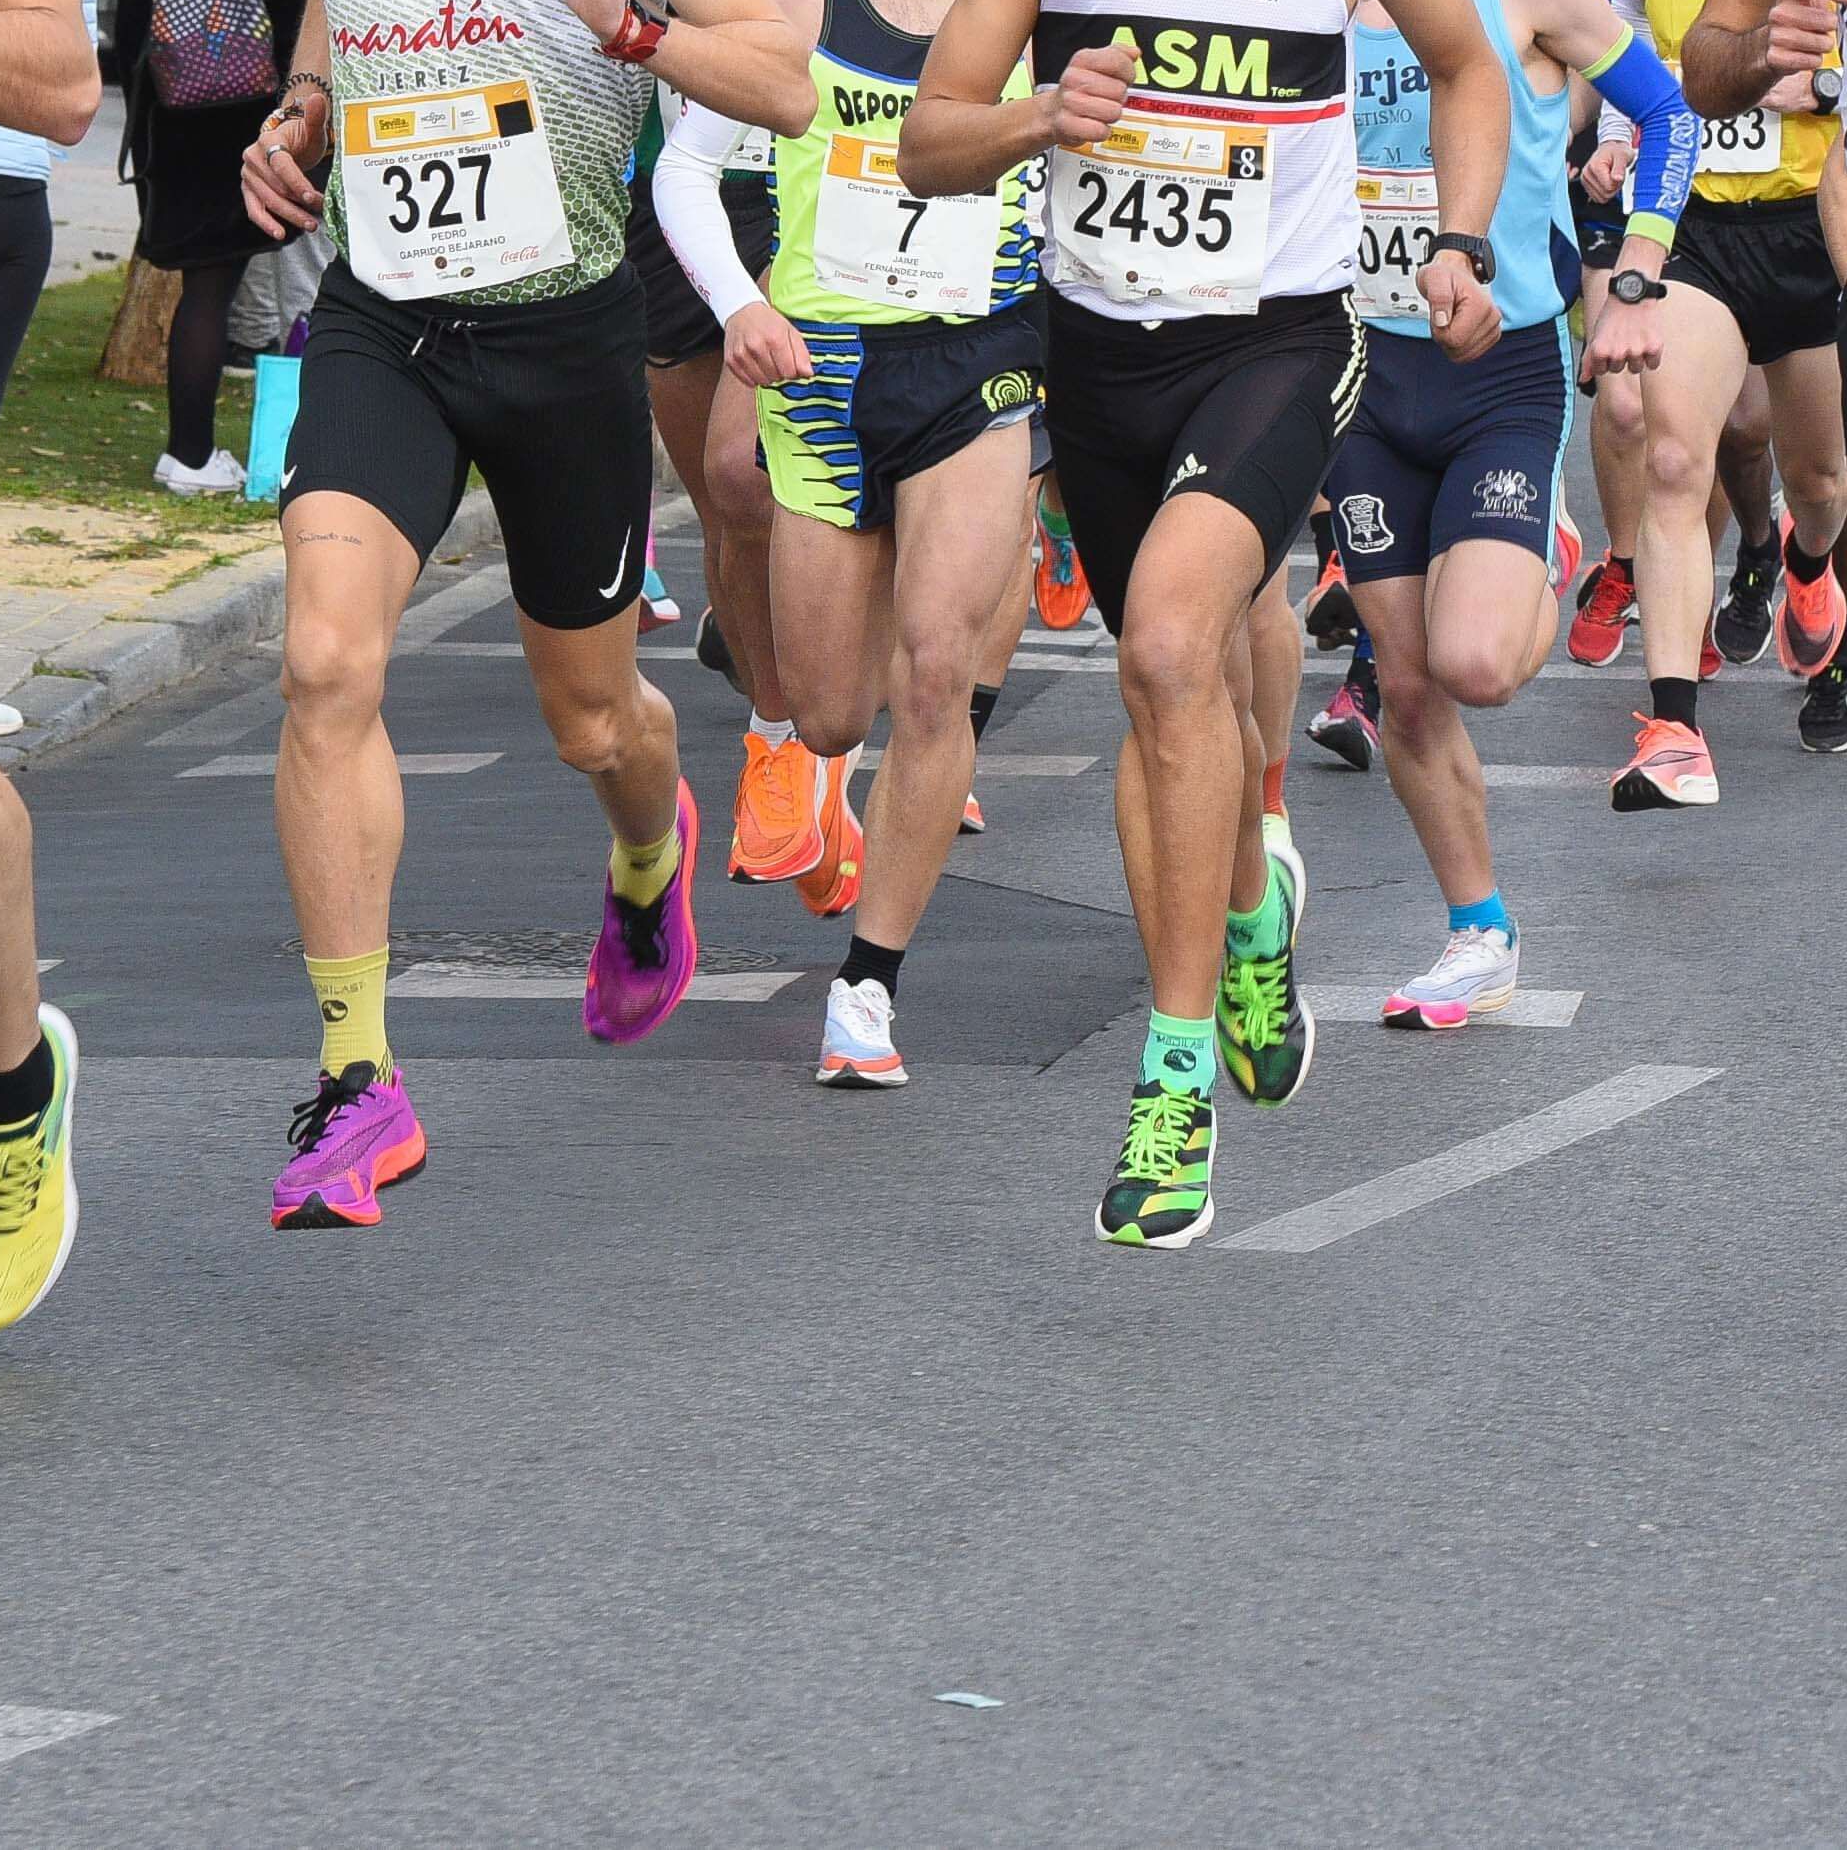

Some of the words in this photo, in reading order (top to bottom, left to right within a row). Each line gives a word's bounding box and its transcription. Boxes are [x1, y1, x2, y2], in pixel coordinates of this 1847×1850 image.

[379, 66, 471, 90] JEREZ
[1271, 86, 1302, 98] Team
[363, 157, 395, 168] Circuito
[398, 155, 410, 164] de
[412, 149, 455, 162] Carreras
[458, 140, 511, 155] #Sevilla10
[1240, 148, 1256, 178] 8
[1080, 159, 1114, 175] Circuito
[1117, 168, 1130, 177] de
[1133, 170, 1177, 183] Carreras
[1181, 176, 1236, 188] #Sevilla10
[382, 153, 492, 233] 327
[848, 182, 880, 196] Circuito
[883, 188, 894, 197] de
[1074, 171, 1233, 252] 2435
[431, 229, 467, 242] PEDRO
[897, 199, 928, 253] 7
[399, 246, 445, 260] GARRIDO
[448, 235, 506, 253] BEJARANO
[864, 262, 918, 279] FERNÁNDEZ
[920, 270, 944, 280] POZO
[892, 257, 919, 266] JAIME
